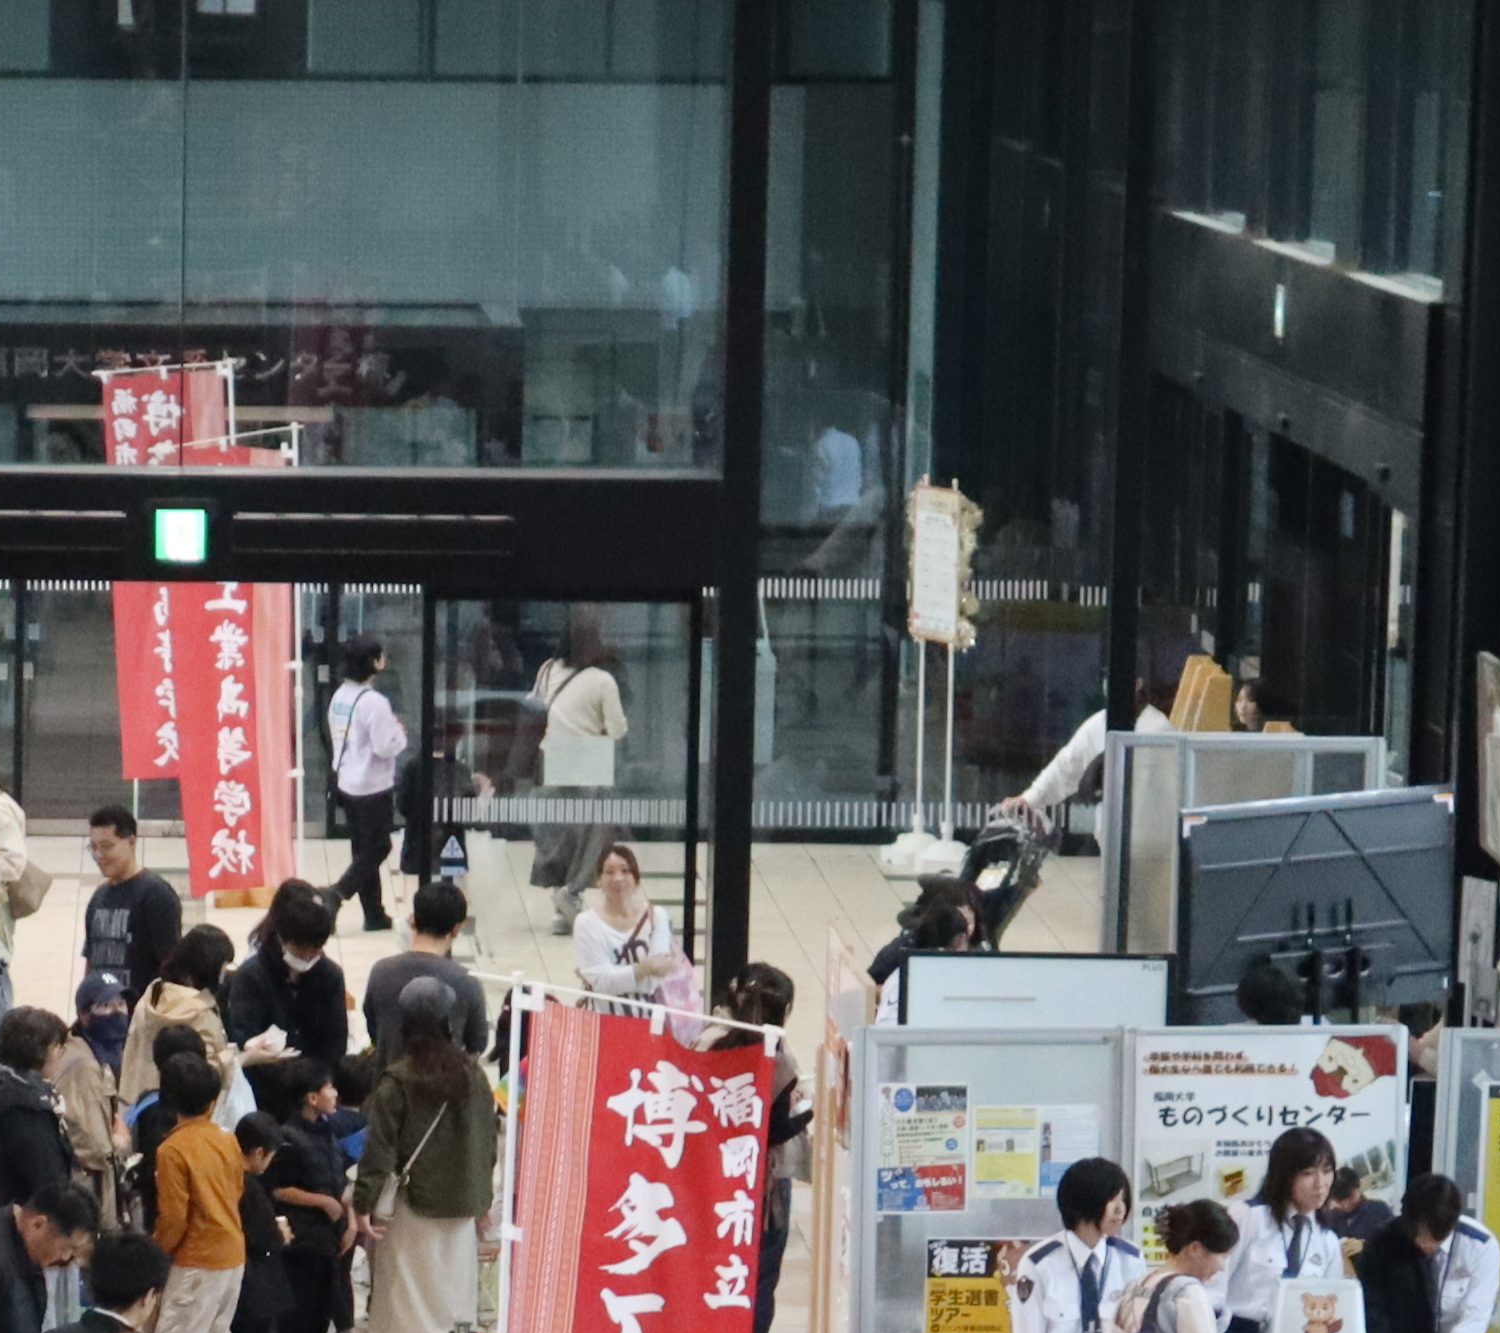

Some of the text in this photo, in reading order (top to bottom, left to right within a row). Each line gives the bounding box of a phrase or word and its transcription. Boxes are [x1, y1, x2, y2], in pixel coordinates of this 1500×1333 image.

[1158, 1105, 1371, 1127] ものづくりセンター
[703, 1071, 764, 1311] 福岡市立
[932, 1246, 989, 1275] 復活
[929, 1289, 999, 1306] 学生選書
[930, 1308, 971, 1323] ツアー
